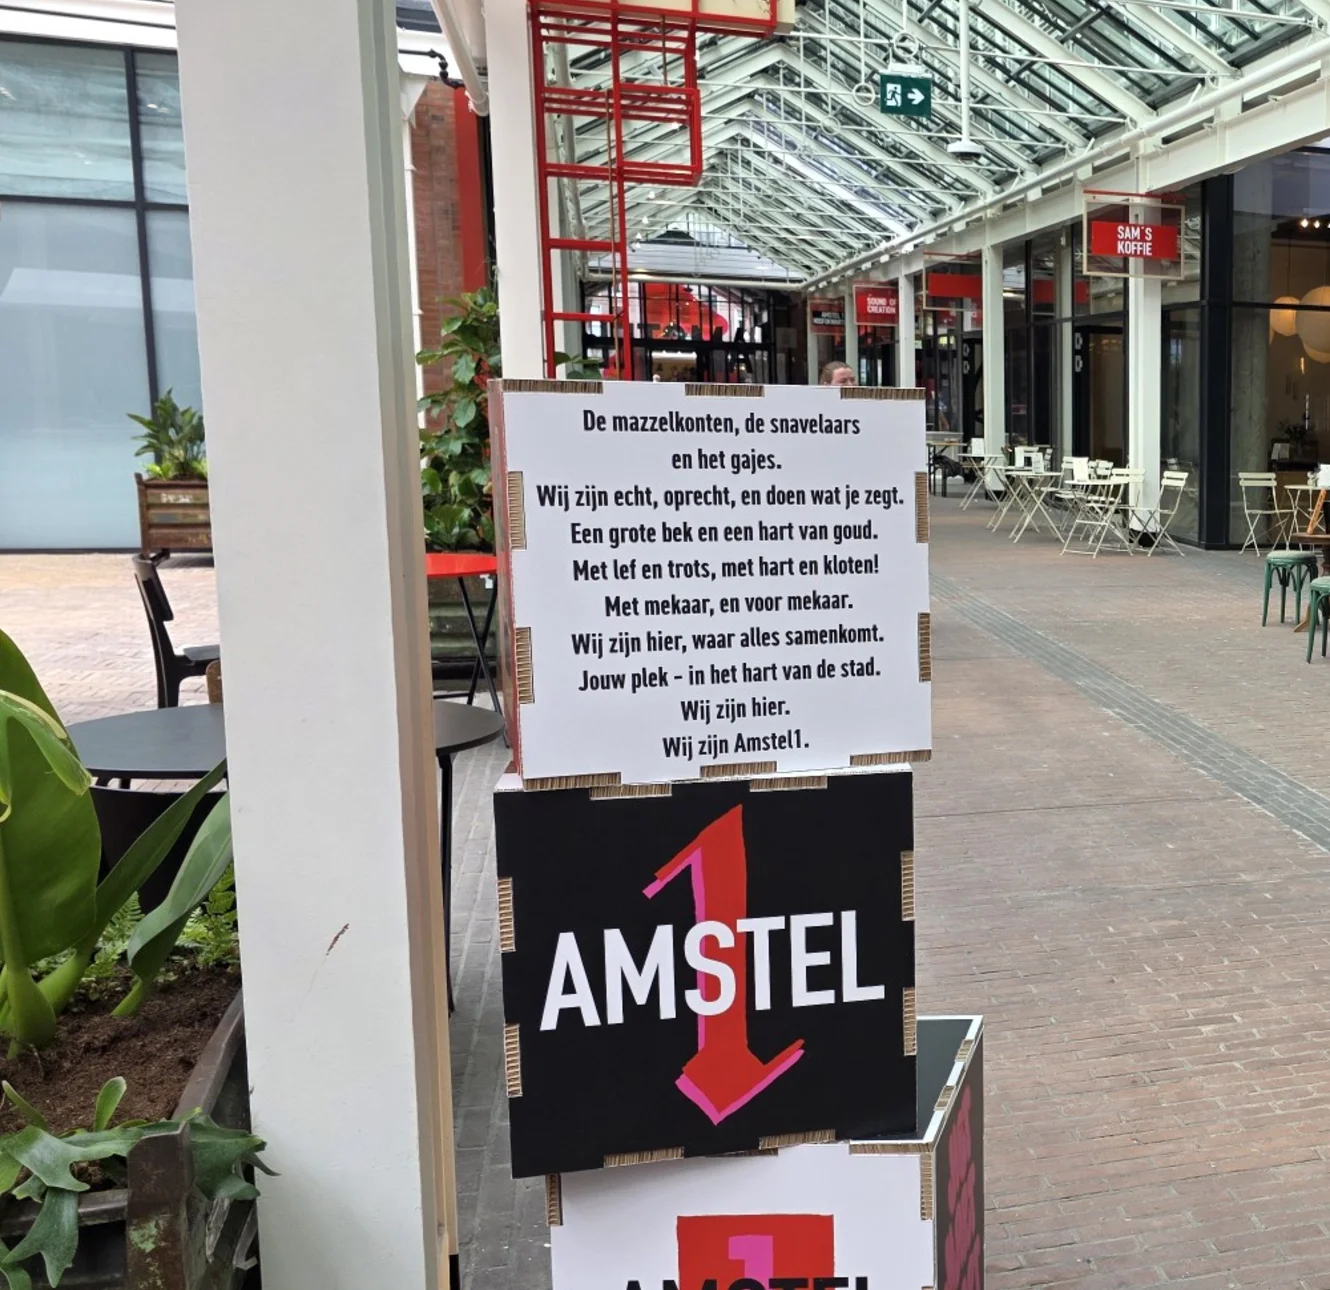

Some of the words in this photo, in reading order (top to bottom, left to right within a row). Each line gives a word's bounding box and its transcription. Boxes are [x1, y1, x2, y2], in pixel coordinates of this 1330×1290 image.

[1117, 240, 1153, 256] KOFFIE
[867, 297, 887, 306] SOUND
[867, 305, 897, 314] CREATION
[582, 409, 607, 432] De
[612, 410, 740, 437] mazzelkonten,
[744, 412, 765, 434] de
[769, 413, 861, 435] snavelaars
[671, 453, 693, 470] en
[697, 448, 726, 470] het
[730, 448, 782, 475] gajes.
[536, 484, 570, 512] Wij
[574, 484, 609, 512] zijn
[613, 484, 658, 510] echt,
[663, 484, 736, 512] oprecht,
[741, 489, 762, 506] en
[766, 484, 806, 506] doen
[810, 486, 841, 505] wat
[845, 484, 860, 510] je
[864, 486, 904, 510] zegt.
[570, 522, 604, 544] Een
[608, 523, 657, 549] grote
[661, 521, 694, 543] bek
[697, 526, 719, 543] en
[723, 525, 754, 542] een
[758, 520, 794, 541] hart
[798, 524, 829, 541] van
[833, 519, 879, 545] goud.
[572, 559, 609, 581] Met
[613, 558, 637, 580] lef
[641, 563, 663, 580] en
[667, 559, 717, 582] trots,
[721, 558, 755, 578] met
[758, 555, 795, 577] hart
[798, 559, 819, 576] en
[823, 553, 879, 575] kloten!
[604, 595, 640, 617] Met
[644, 593, 715, 617] mekaar,
[719, 597, 740, 614] en
[744, 595, 783, 613] voor
[787, 589, 854, 611] mekaar.
[571, 632, 603, 660] Wij
[608, 631, 642, 658] zijn
[646, 630, 687, 654] hier,
[691, 632, 736, 650] waar
[740, 626, 780, 648] alles
[785, 623, 884, 646] samenkomt.
[578, 670, 626, 692] Jouw
[631, 666, 669, 694] plek
[688, 664, 705, 686] in
[710, 663, 738, 685] het
[742, 662, 778, 683] hart
[781, 664, 812, 681] van
[816, 658, 836, 679] de
[840, 656, 881, 678] stad.
[680, 699, 711, 725] Wij
[716, 698, 747, 724] zijn
[751, 696, 791, 717] hier.
[662, 735, 693, 762] Wij
[697, 734, 729, 760] zijn
[733, 728, 810, 753] Amstel1.
[539, 909, 886, 1032] AMSTEL
